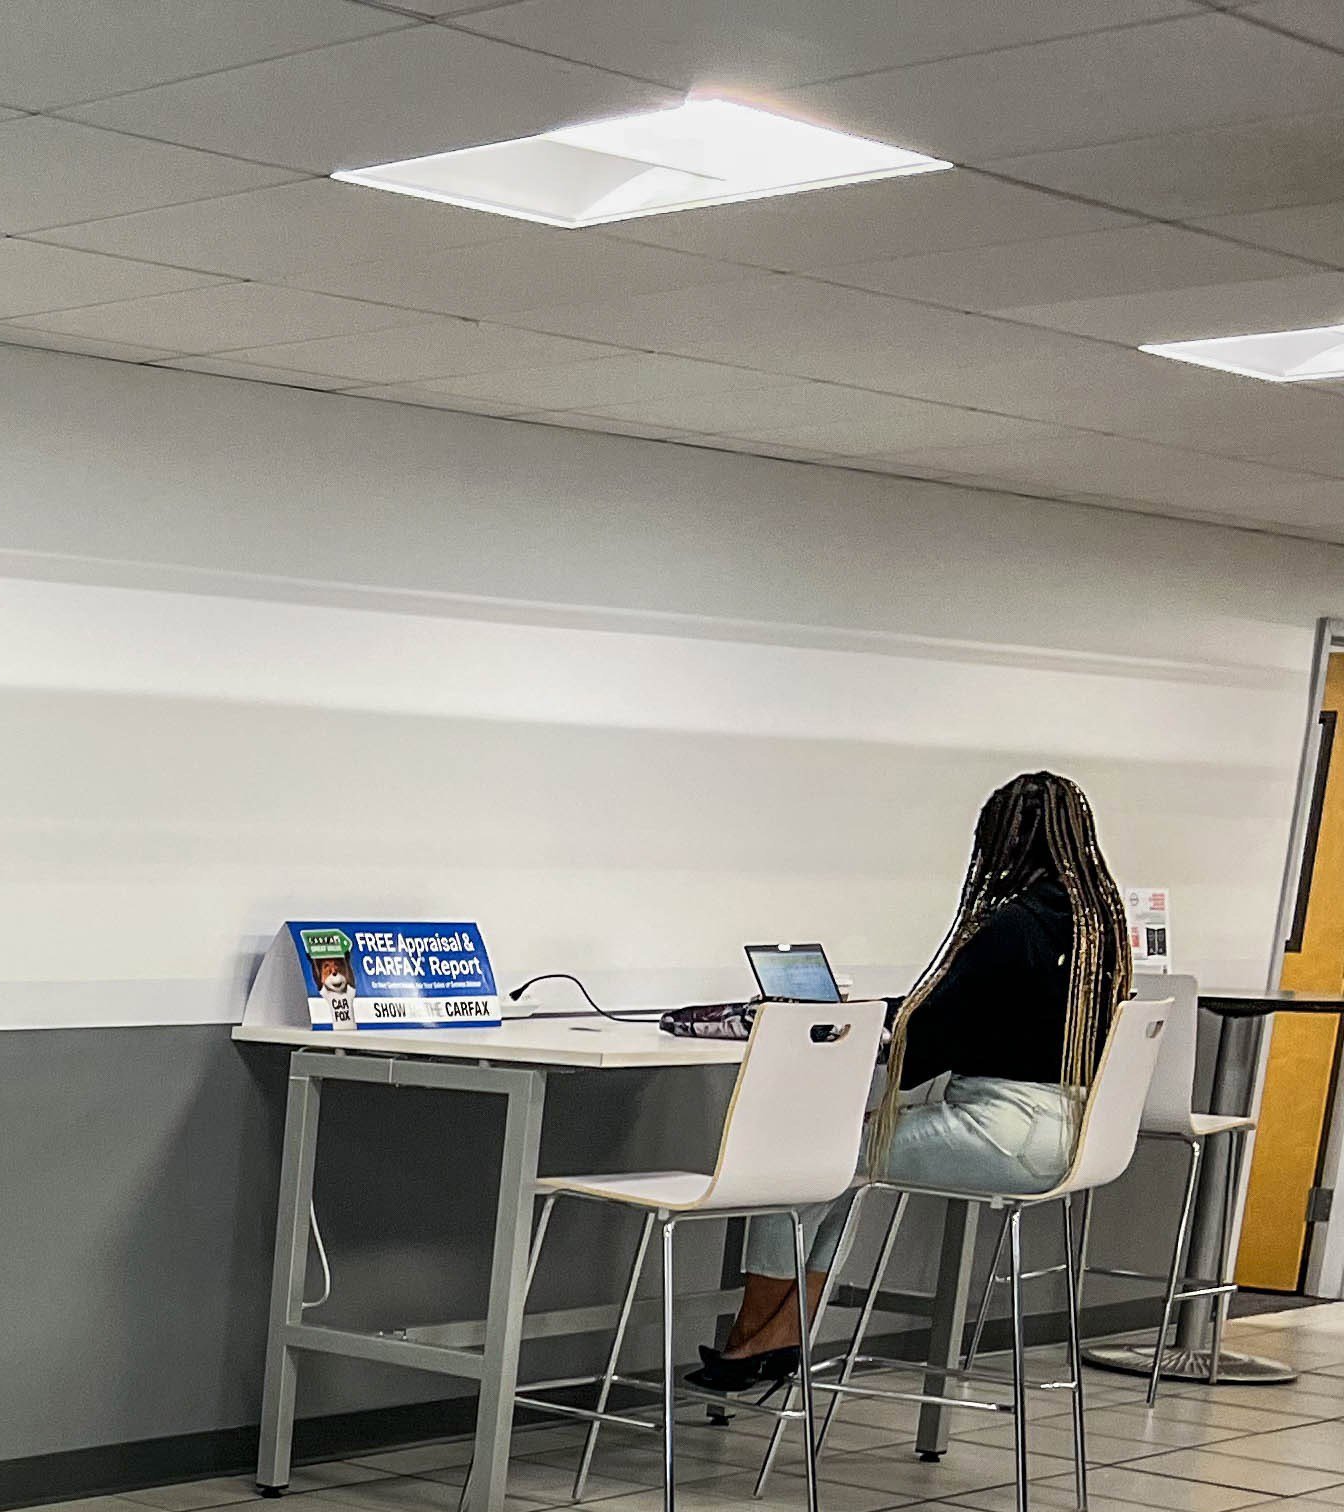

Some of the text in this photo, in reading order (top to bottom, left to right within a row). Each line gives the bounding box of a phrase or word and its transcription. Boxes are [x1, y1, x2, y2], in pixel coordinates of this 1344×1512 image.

[355, 932, 396, 953] FREE
[397, 931, 462, 958] Appraisal
[462, 933, 475, 952] &
[429, 956, 482, 979] Report
[332, 998, 349, 1010] CAR
[374, 1002, 406, 1018] SHOW
[445, 1000, 490, 1017] CARFAX
[334, 1010, 351, 1022] FOX
